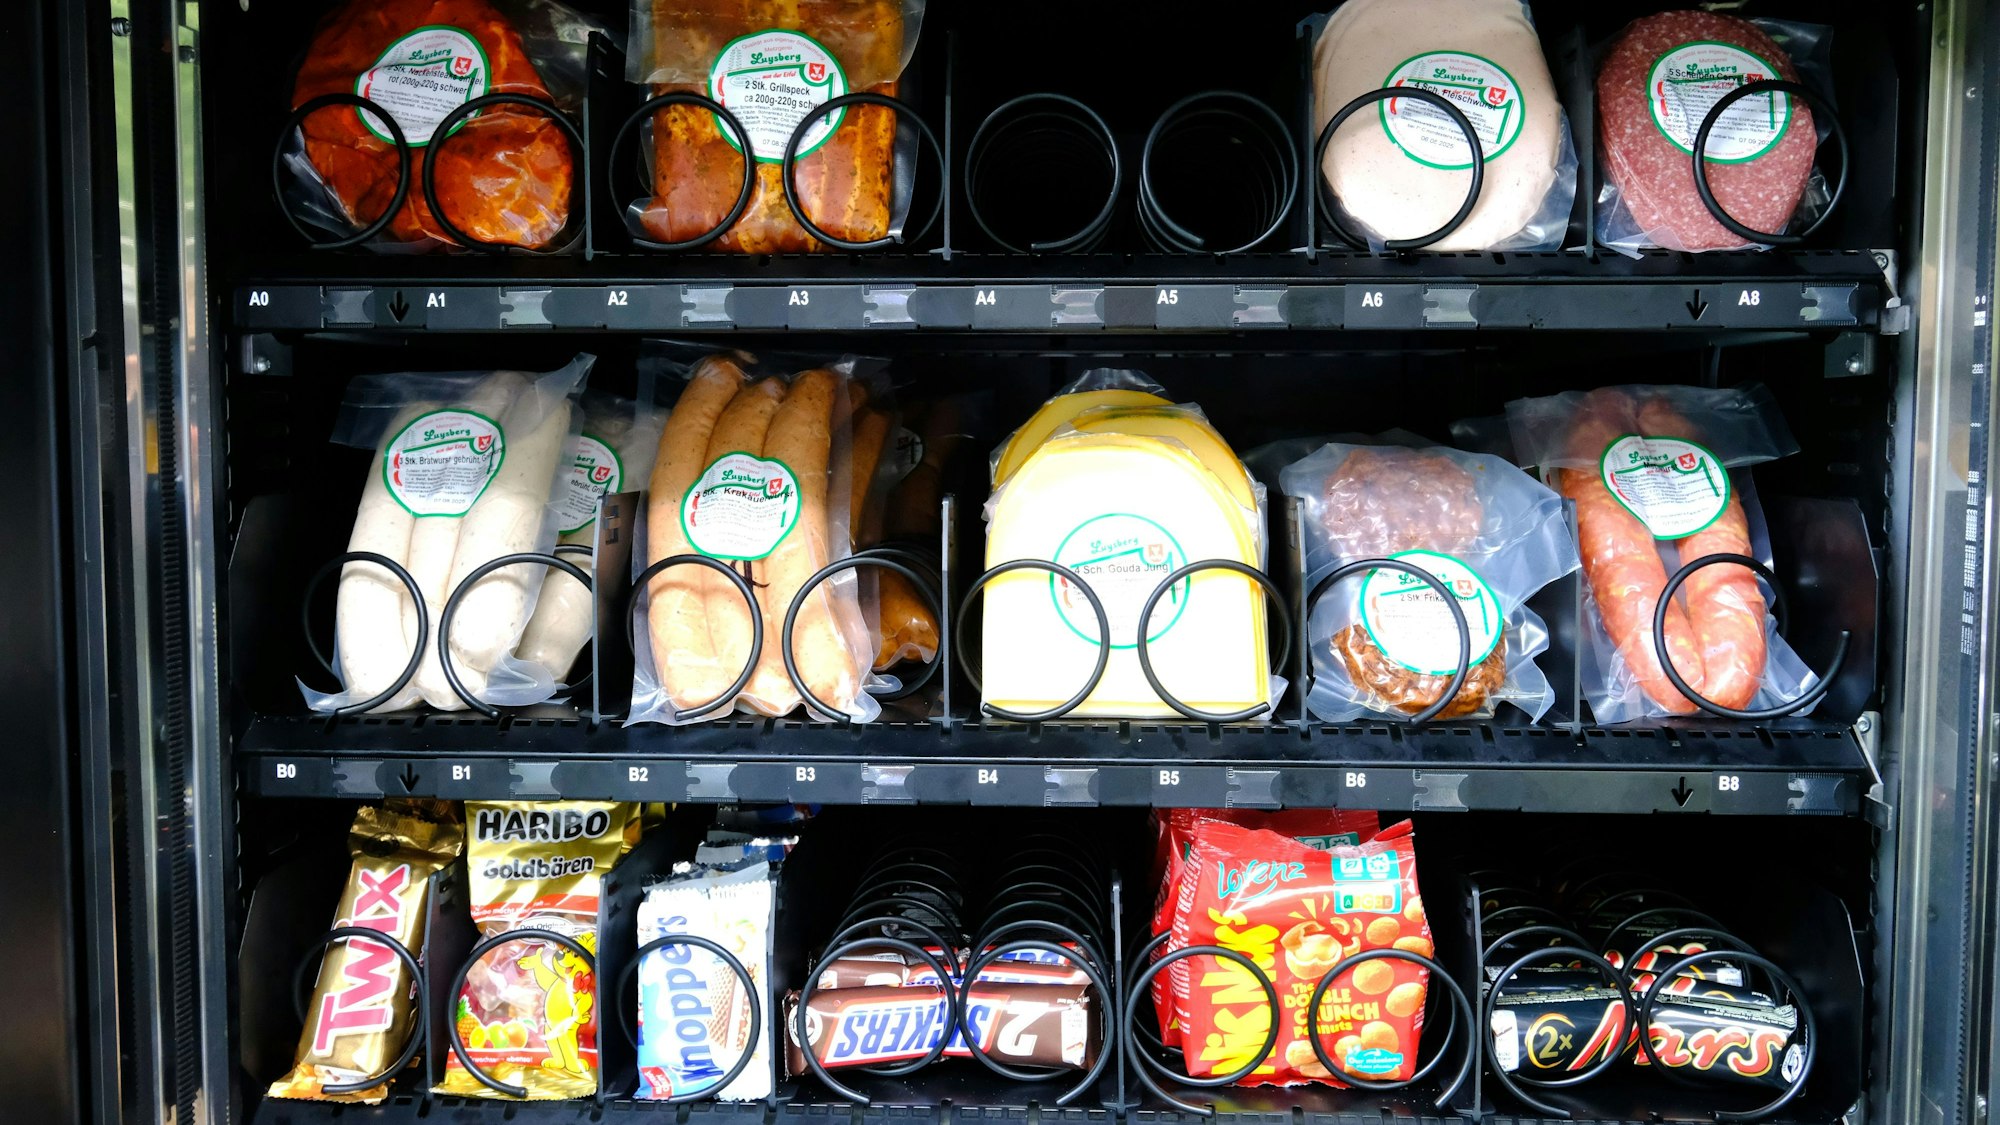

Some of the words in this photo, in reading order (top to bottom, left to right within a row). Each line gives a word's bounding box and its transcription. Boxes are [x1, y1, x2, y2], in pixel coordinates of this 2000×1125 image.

[409, 48, 452, 61] Luysberg
[750, 52, 802, 65] Luysberg
[1433, 68, 1484, 85] Luysberg
[1686, 63, 1737, 76] Luysberg
[389, 76, 400, 84] rot
[400, 77, 438, 92] (200g-220g
[439, 83, 468, 95] schwer
[745, 80, 751, 89] 2
[752, 80, 768, 90] Stk.
[769, 82, 811, 96] Grillspeck
[744, 95, 754, 103] ca
[755, 94, 798, 109] 200g-220g
[1443, 89, 1498, 111] Fleischwurst
[250, 292, 269, 306] A0
[427, 292, 446, 307] A1
[608, 291, 627, 305] A2
[790, 291, 809, 305] A3
[976, 290, 996, 305] A4
[1157, 289, 1178, 304] A5
[1362, 292, 1383, 307] A6
[1738, 290, 1760, 305] A8
[424, 429, 471, 442] Luysberg
[399, 457, 404, 465] 3
[405, 457, 418, 465] Stk.
[420, 456, 451, 465] Bratwurst
[722, 469, 766, 484] Luysberg
[571, 478, 590, 493] ebrüht,
[1090, 537, 1139, 555] Luysberg
[1074, 566, 1081, 574] 4
[1084, 565, 1105, 575] Sch.
[1108, 564, 1141, 574] Gouda
[1144, 563, 1169, 576] Jung
[1400, 594, 1405, 602] 2
[277, 764, 296, 778] B0
[453, 765, 471, 780] B1
[629, 767, 648, 782] B2
[796, 767, 815, 781] B3
[979, 769, 998, 784] B4
[1160, 771, 1180, 785] B5
[1346, 772, 1366, 787] B6
[1719, 776, 1739, 791] B8
[477, 807, 610, 843] HARIBO
[482, 855, 596, 881] Goldbären
[1217, 859, 1308, 900] Lorenz
[1291, 983, 1315, 995] The
[1284, 988, 1353, 1009] DOBLE
[996, 1001, 1050, 1058] 2
[1538, 1025, 1573, 1060] 2x
